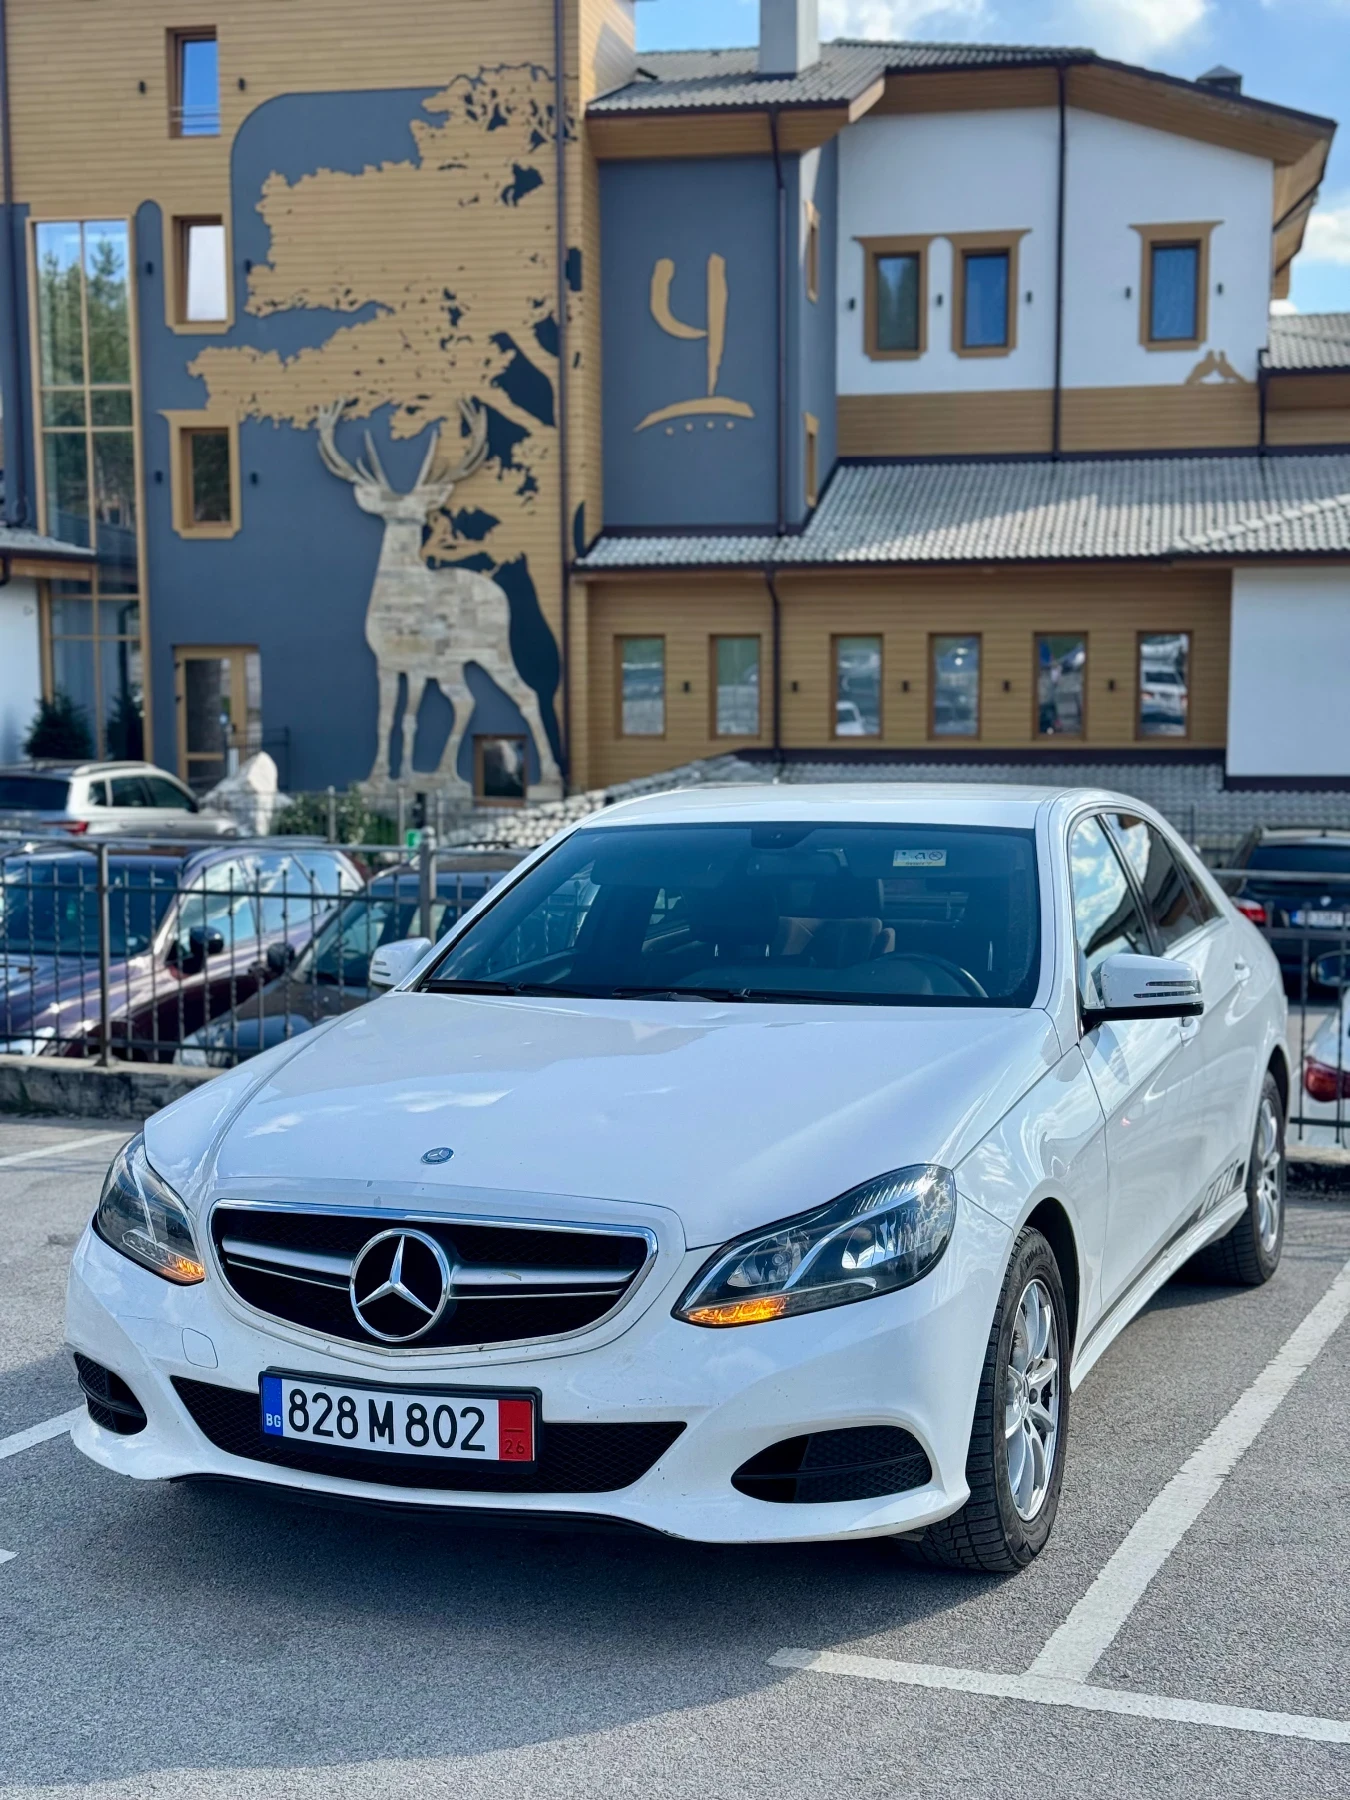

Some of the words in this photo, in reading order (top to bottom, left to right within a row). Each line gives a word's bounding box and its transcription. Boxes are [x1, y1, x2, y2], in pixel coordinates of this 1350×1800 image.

[266, 1413, 282, 1428] BG
[288, 1388, 359, 1440] 828
[368, 1398, 395, 1445] M
[405, 1402, 486, 1452] 802
[504, 1439, 526, 1455] 26
